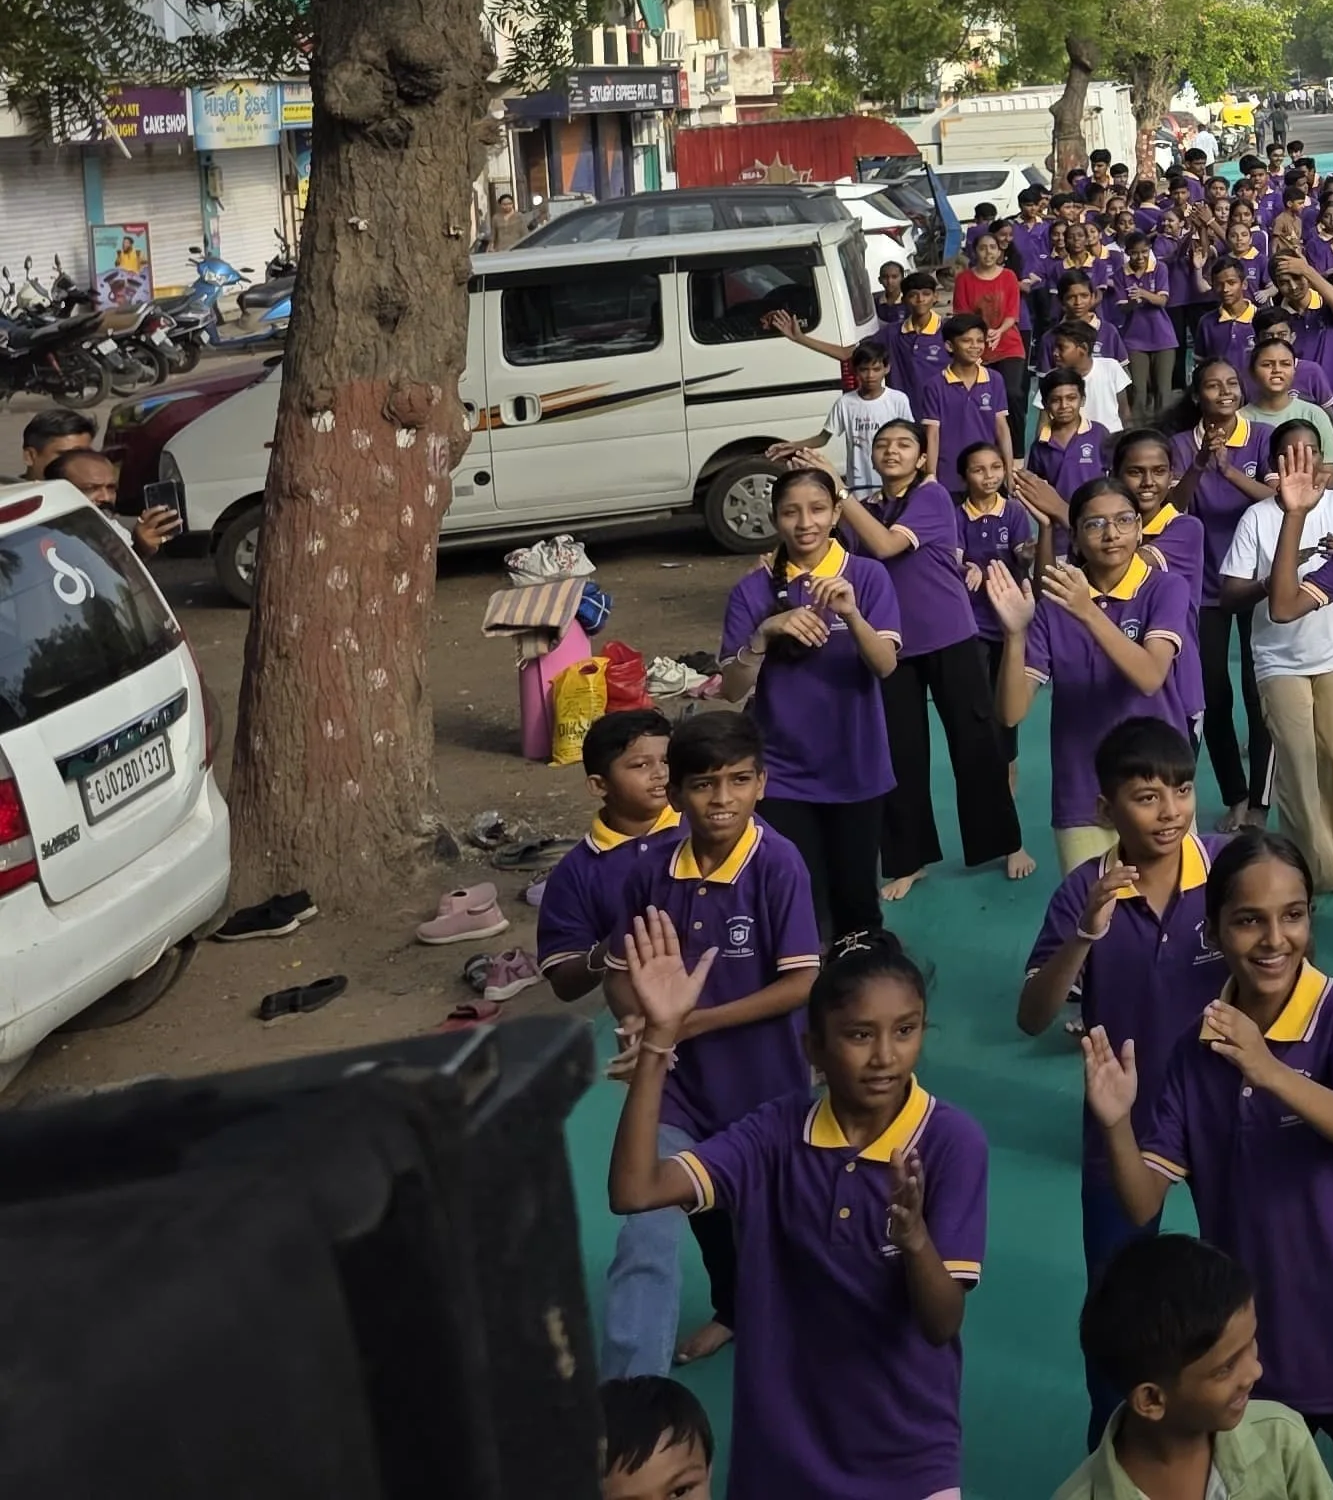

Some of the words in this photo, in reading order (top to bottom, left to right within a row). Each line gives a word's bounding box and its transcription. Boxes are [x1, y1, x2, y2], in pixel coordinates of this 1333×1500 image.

[615, 83, 637, 102] EXPRESS
[105, 123, 138, 138] DLIGHT
[142, 114, 166, 135] CAKE
[165, 113, 186, 133] SHOP
[95, 742, 167, 805] GJ02BD1337
